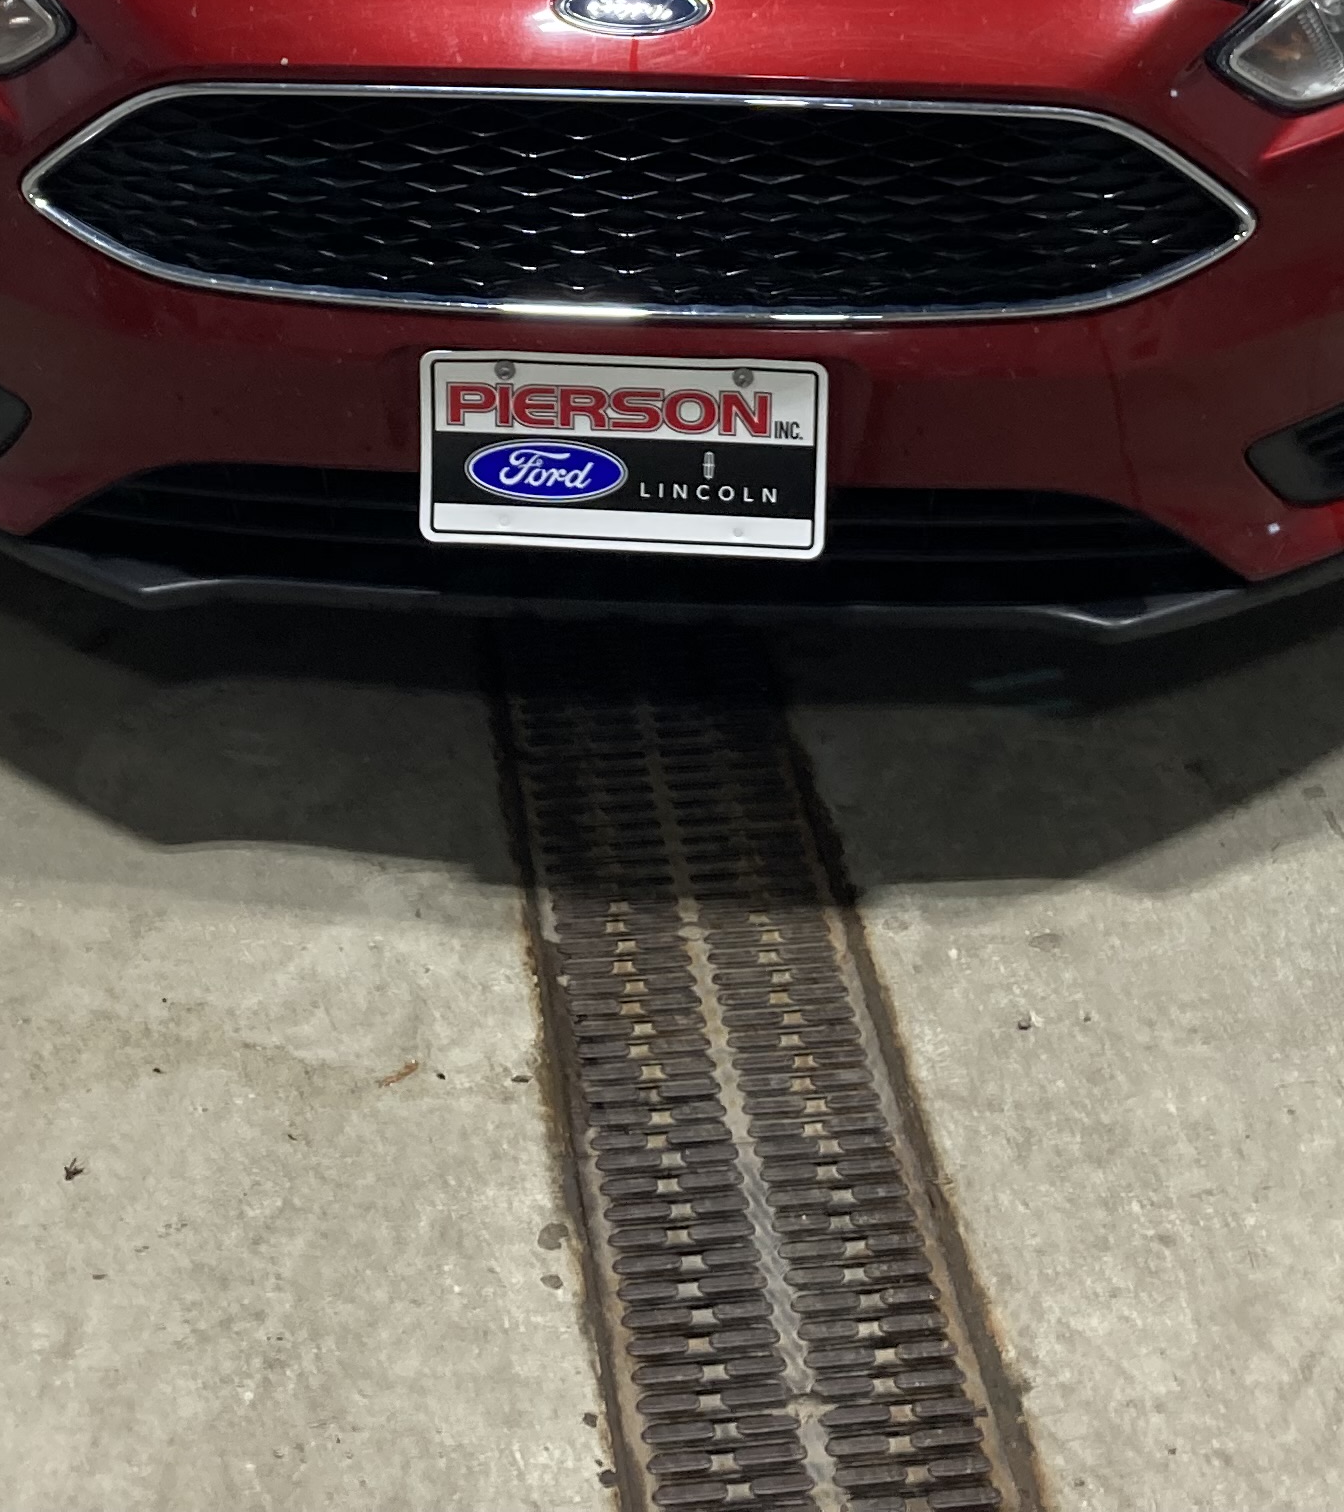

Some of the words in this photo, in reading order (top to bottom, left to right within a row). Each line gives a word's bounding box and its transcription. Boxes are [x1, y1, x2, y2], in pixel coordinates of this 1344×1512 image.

[446, 381, 772, 438] PIERSON
[774, 419, 804, 440] INC.
[499, 449, 594, 489] Ford
[640, 482, 778, 504] LINCOLN
